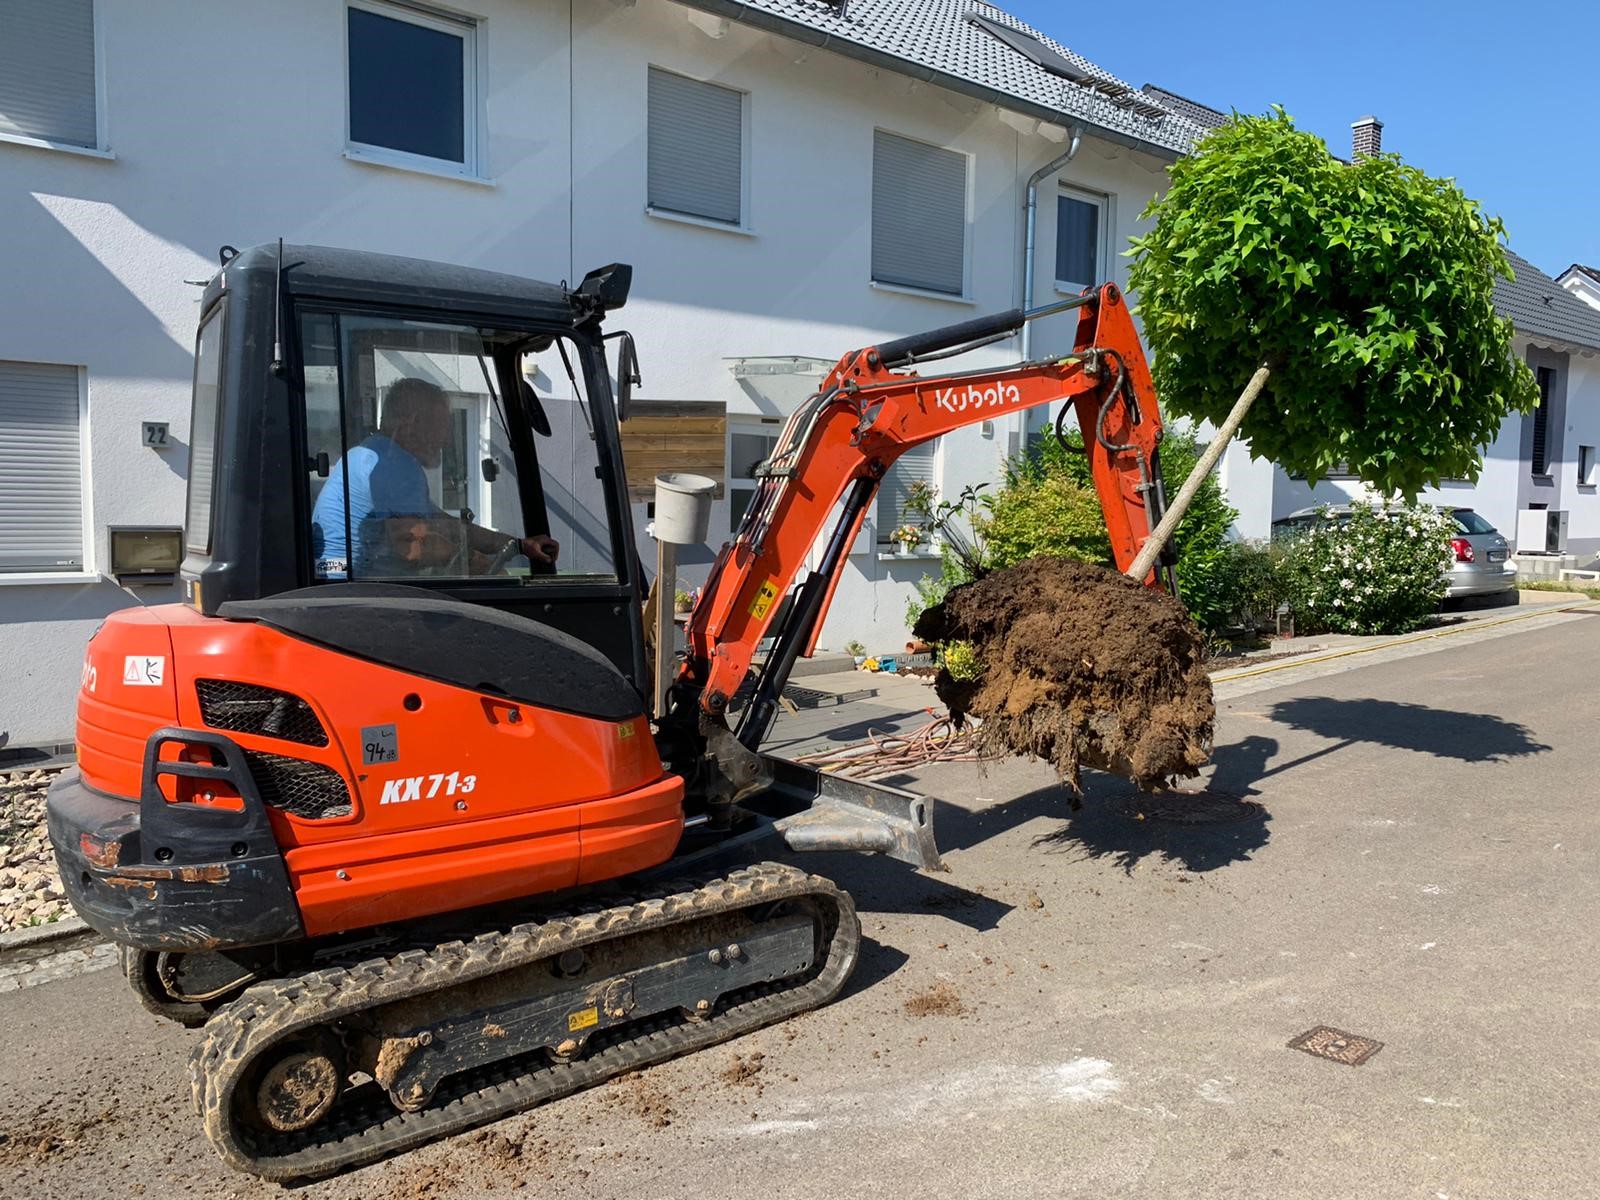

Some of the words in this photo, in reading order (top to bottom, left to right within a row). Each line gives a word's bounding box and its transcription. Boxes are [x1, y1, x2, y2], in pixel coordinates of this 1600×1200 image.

[935, 381, 1020, 413] Kubota
[147, 426, 167, 444] 22
[365, 743, 386, 762] 94
